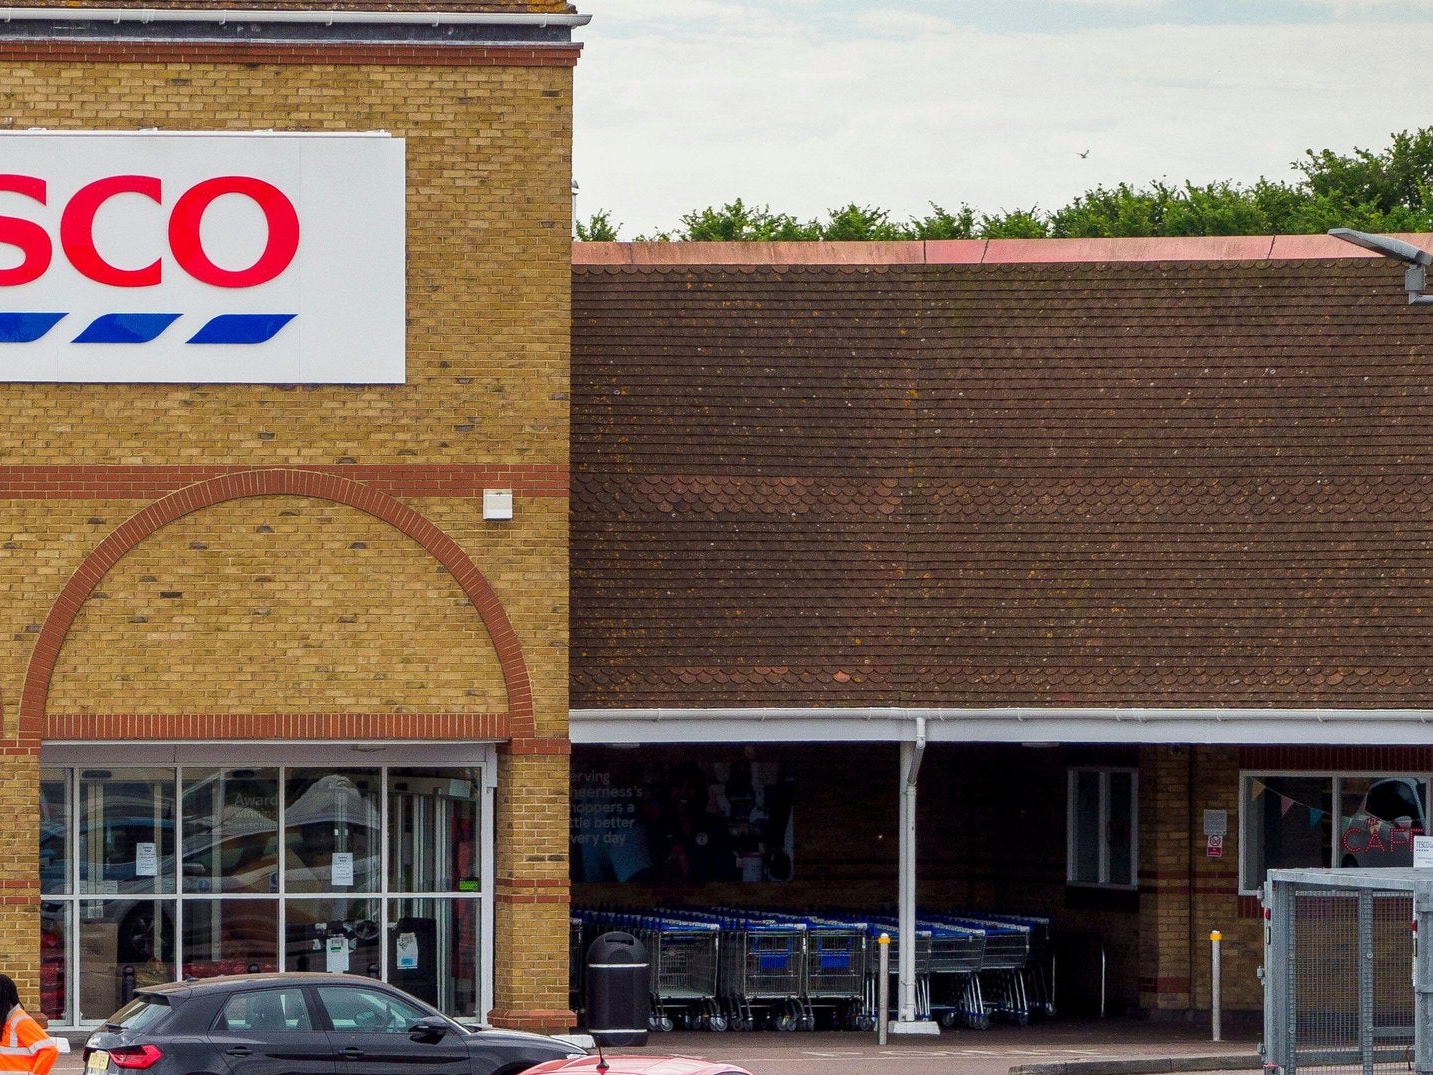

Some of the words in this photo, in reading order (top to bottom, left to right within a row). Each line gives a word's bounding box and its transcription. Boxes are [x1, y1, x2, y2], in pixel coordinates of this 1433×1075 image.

[570, 770, 610, 784] erving
[595, 816, 636, 829] better
[570, 833, 599, 847] very
[603, 831, 626, 847] day
